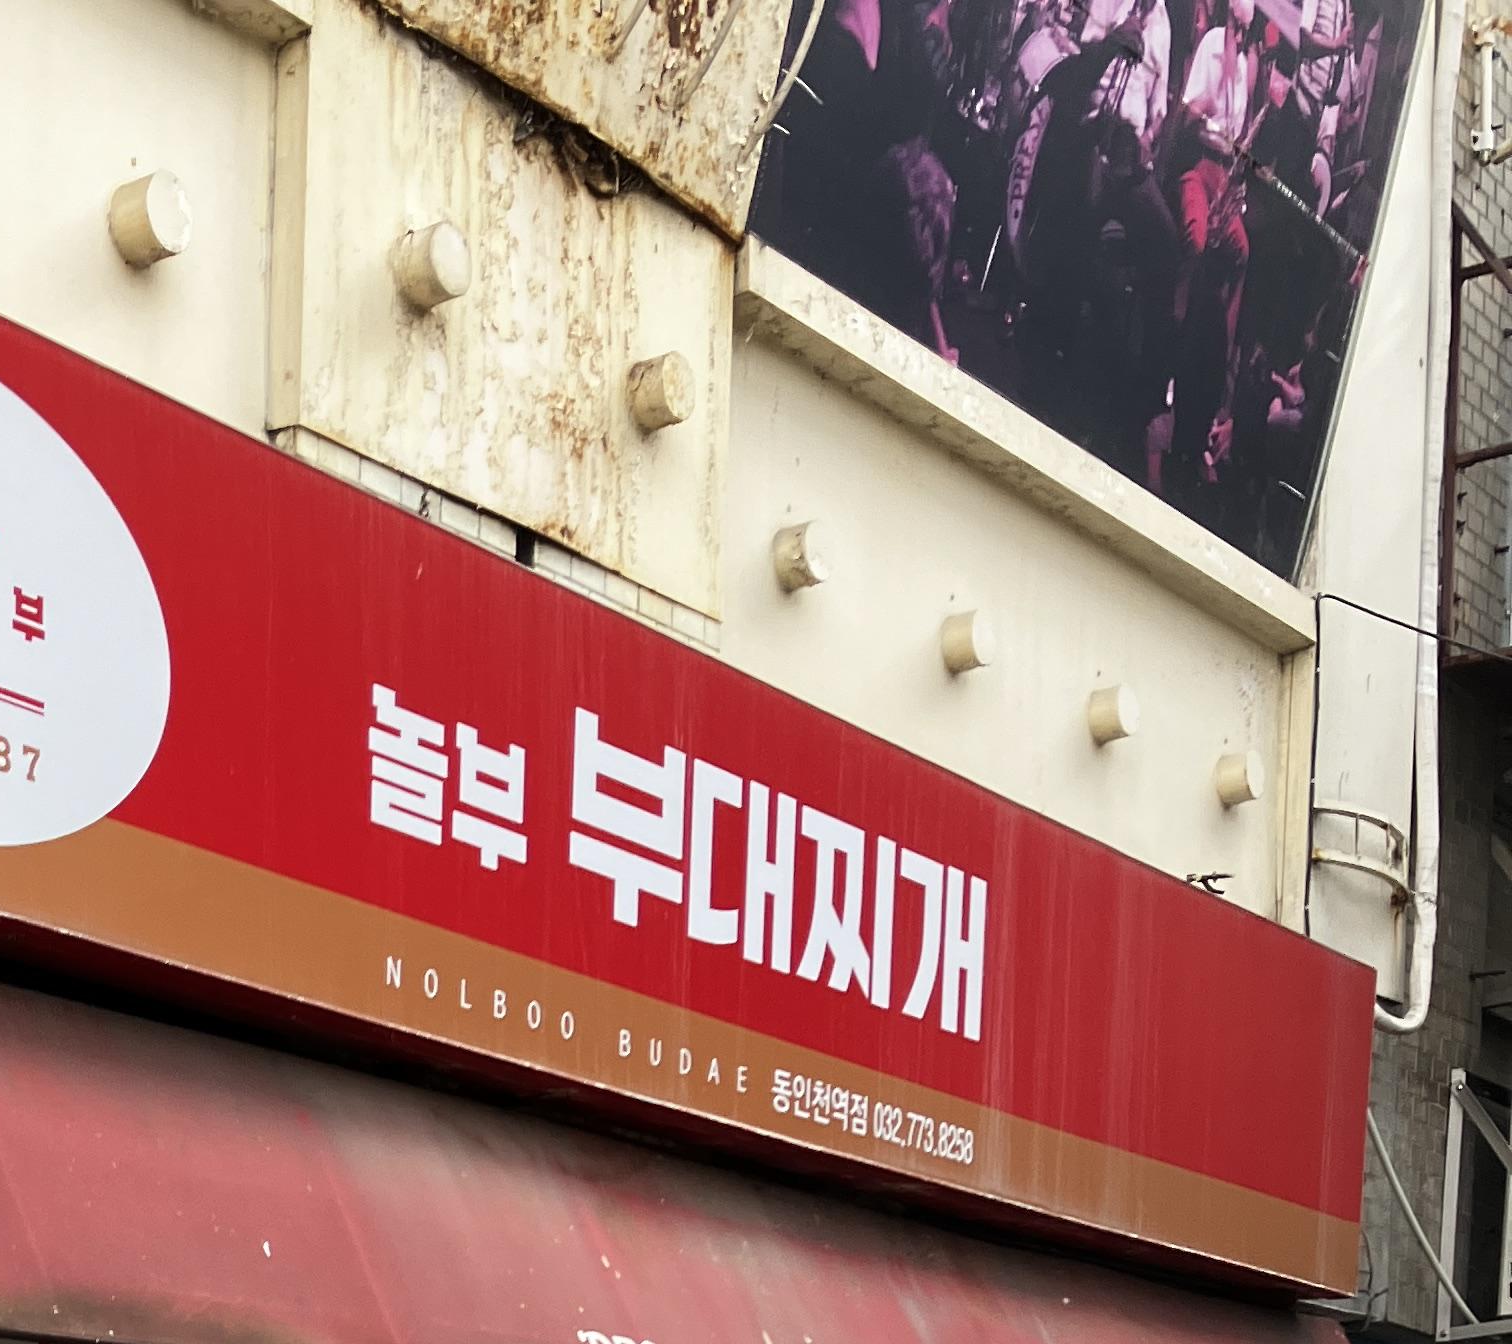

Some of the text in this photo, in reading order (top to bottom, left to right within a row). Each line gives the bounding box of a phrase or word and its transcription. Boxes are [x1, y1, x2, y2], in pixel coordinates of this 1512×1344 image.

[12, 587, 46, 641] 부
[368, 683, 987, 1042] 놀부 부대찌개
[385, 955, 748, 1093] NOLBOO BUDAE
[771, 1068, 974, 1164] 동인천역점 032.773.8258
